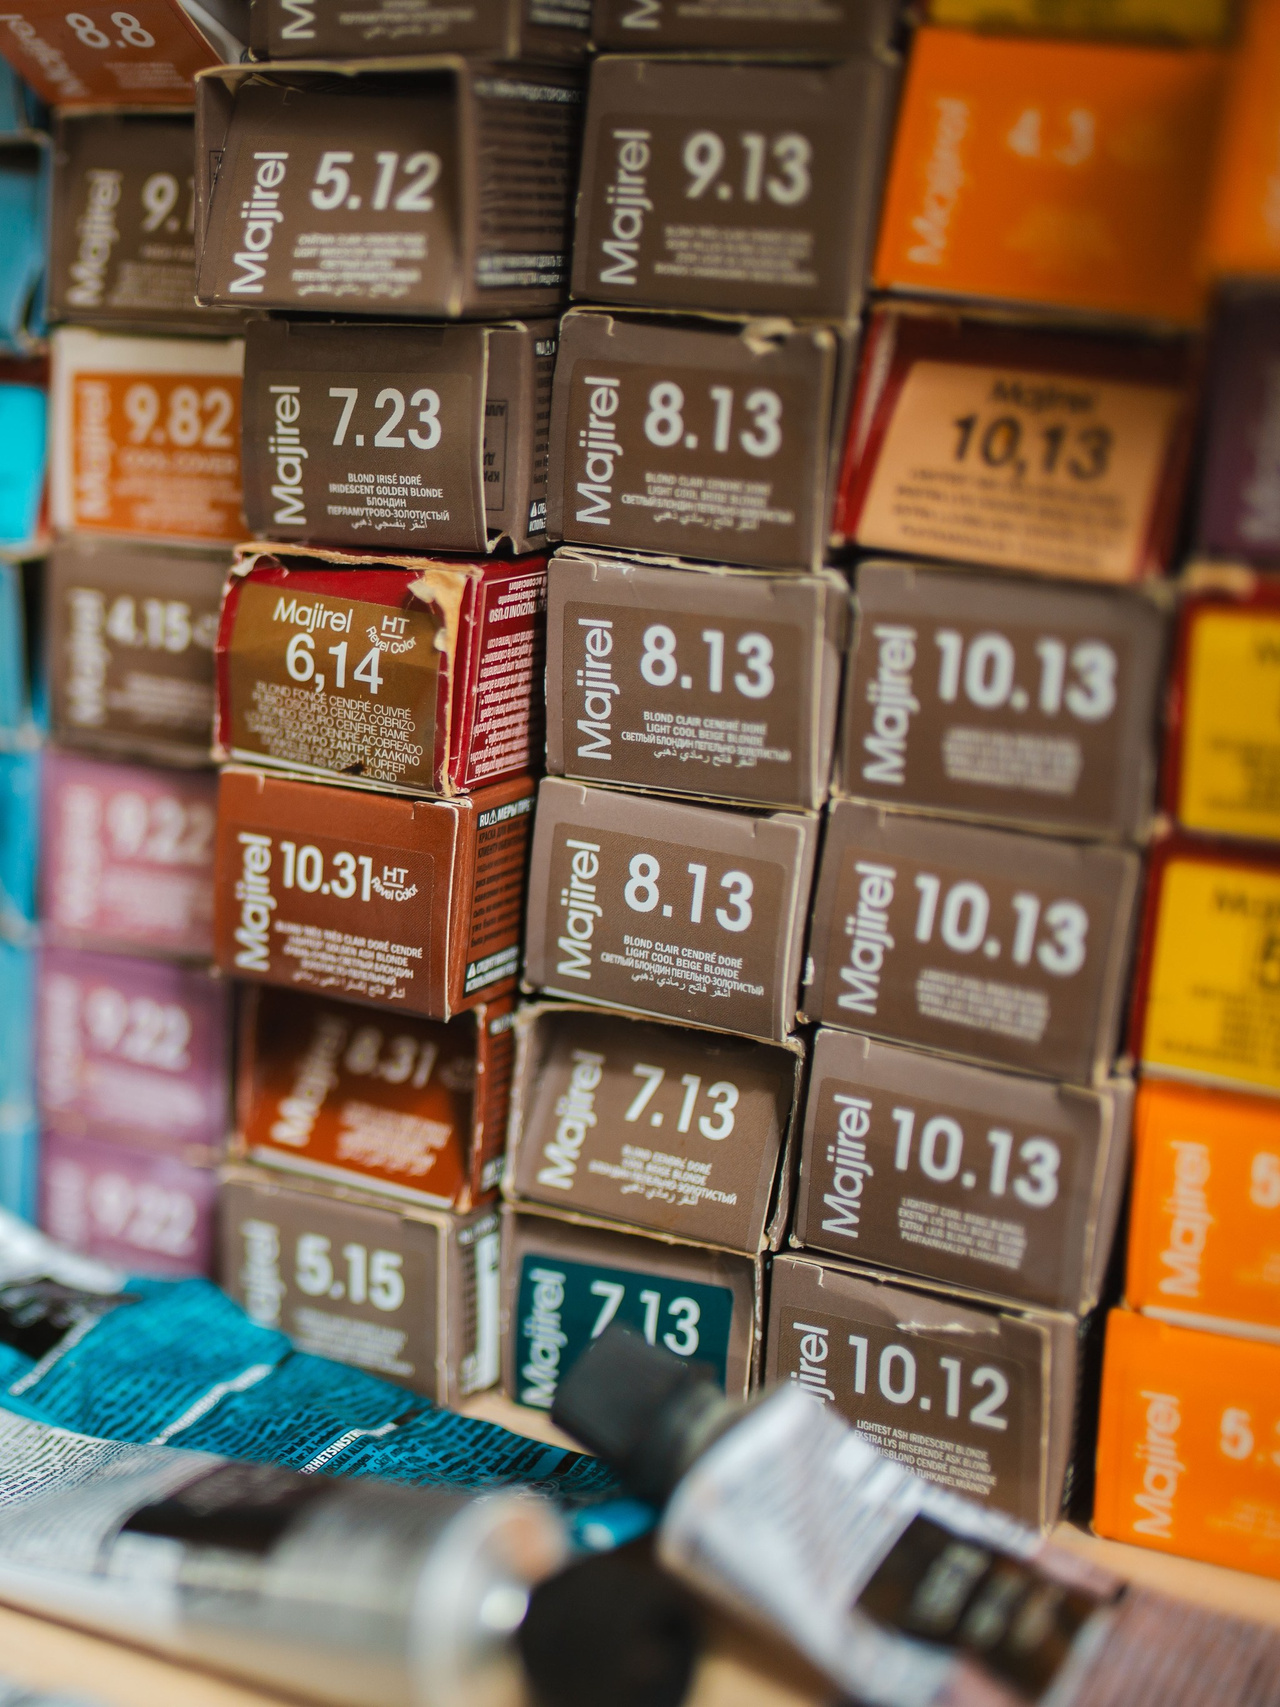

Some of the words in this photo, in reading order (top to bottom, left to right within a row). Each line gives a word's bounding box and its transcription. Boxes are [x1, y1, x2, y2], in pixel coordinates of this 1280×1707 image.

[65, 12, 155, 49] 8.8
[310, 151, 442, 211] 5.12
[683, 130, 812, 205] 9.13
[68, 168, 122, 306] Majirel
[229, 152, 289, 293] Majirel
[600, 130, 653, 285] Majirel
[124, 383, 233, 447] 9.82
[329, 387, 442, 450] 7.23
[644, 381, 783, 458] 8.13
[269, 385, 309, 524] Majirel
[576, 377, 623, 525] Majirel
[954, 414, 1114, 482] 10,13
[328, 483, 374, 495] IRIDESCENT
[376, 485, 408, 498] GOLDEN
[410, 488, 444, 498] BLONDE
[347, 473, 375, 483] BLOND
[376, 473, 398, 484] IRISÉ
[399, 474, 422, 486] DORÉ
[366, 496, 407, 508] БЛОНДИН
[327, 505, 450, 521] ПЕРЛАМУТРОВО-ЗОЛОТИСТЫЙ
[106, 594, 192, 653] 4.15
[273, 597, 353, 633] Majirel
[366, 626, 390, 652] Revel
[390, 637, 417, 654] Color
[381, 615, 410, 634] HT
[489, 606, 509, 622] D'USO
[286, 633, 383, 694] 6,14
[577, 618, 620, 761] Majirel
[639, 624, 775, 699] 8.13
[936, 628, 1117, 722] 10.13
[285, 698, 328, 716] OSCURO
[330, 707, 367, 723] CENIZA
[369, 714, 416, 732] COBRIZO
[293, 688, 327, 704] FONCÉ
[329, 695, 371, 713] CENDRÉ
[374, 704, 412, 721] CUIVRÉ
[298, 711, 335, 728] SCURO
[336, 719, 378, 736] CENERE
[380, 728, 410, 742] RAME
[643, 711, 674, 724] BLOND
[675, 715, 701, 728] CLAIR
[646, 722, 671, 734] LIGHT
[672, 726, 697, 738] COOL
[862, 624, 920, 784] Majirel
[330, 740, 372, 756] ΣΑΝΤΡΕ
[374, 748, 421, 767] ΧΑΛΚΙΝΟ
[336, 751, 364, 764] ASCH
[367, 757, 406, 774] KUPFER
[362, 735, 424, 756] ACOBREADO
[621, 731, 656, 744] СВЕТЛЫЙ
[656, 735, 694, 750] БЛОНДИН
[235, 832, 277, 972] Majirel
[280, 841, 372, 902] 10.31
[371, 877, 395, 900] Revel
[395, 884, 419, 902] Color
[384, 866, 408, 883] HT
[624, 853, 754, 933] 8.13
[556, 839, 603, 980] Majirel
[838, 860, 897, 1014] Majirel
[914, 873, 1089, 976] 10.13
[367, 939, 390, 952] DORÉ
[390, 944, 423, 958] CENDRÉ
[376, 952, 408, 967] BLONDE
[624, 934, 653, 949] BLOND
[654, 941, 679, 956] CLAIR
[681, 947, 717, 964] CENDRÉ
[718, 955, 743, 969] DORÉ
[625, 947, 650, 960] LIGHT
[651, 951, 674, 966] COOL
[676, 958, 702, 972] BEIGE
[703, 963, 739, 980] BLONDE
[634, 959, 671, 976] БЛОНДИН
[537, 1049, 605, 1190] Majirel
[624, 1062, 740, 1141] 7.13
[687, 1160, 712, 1176] DORÉ
[822, 1094, 873, 1238] Majirel
[892, 1107, 1061, 1208] 10.13
[1159, 1140, 1215, 1298] Majirel
[295, 1233, 405, 1311] 5.15
[521, 1268, 568, 1407] Majirel
[590, 1279, 701, 1356] 713
[791, 1322, 835, 1403] jirel
[848, 1334, 1009, 1431] 10.12
[854, 1430, 882, 1444] EKSTRA
[883, 1437, 897, 1448] LYS
[898, 1441, 944, 1461] IRISERENDE
[945, 1452, 961, 1464] ASK
[857, 1419, 891, 1436] LIGHTEST
[892, 1428, 908, 1440] ASH
[909, 1432, 956, 1451] IRIDESCENT
[1134, 1390, 1186, 1538] Majirel
